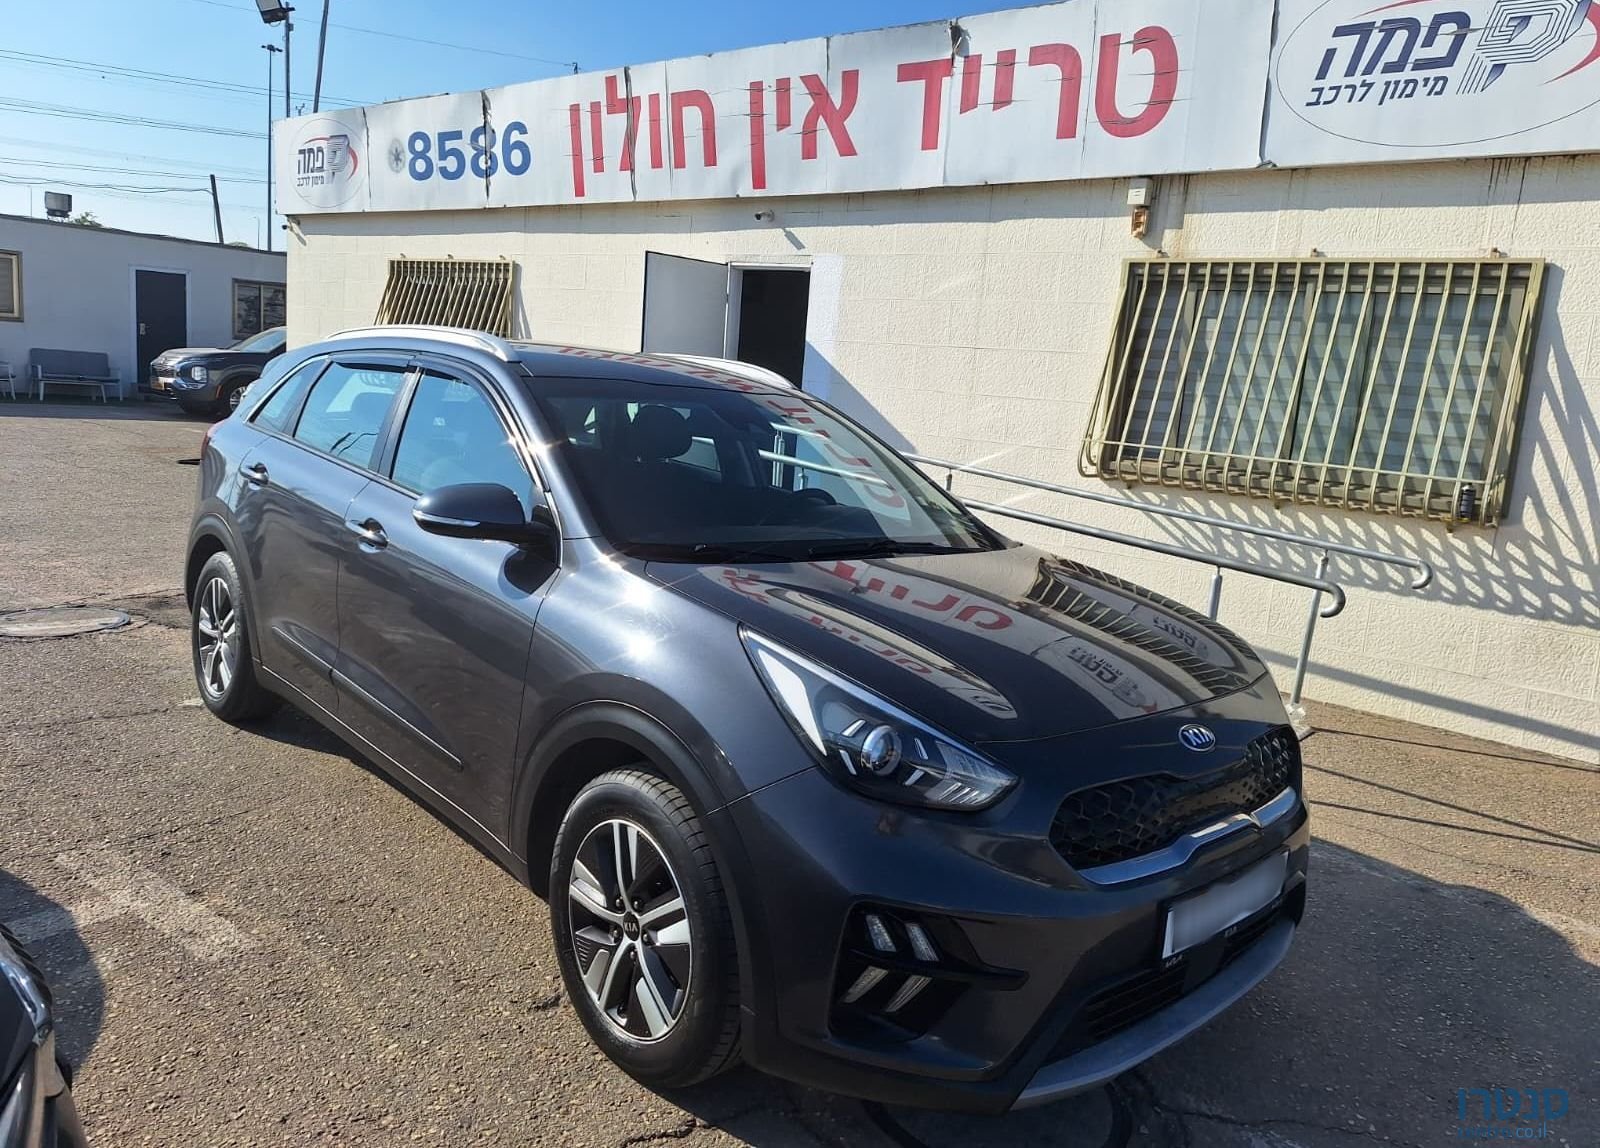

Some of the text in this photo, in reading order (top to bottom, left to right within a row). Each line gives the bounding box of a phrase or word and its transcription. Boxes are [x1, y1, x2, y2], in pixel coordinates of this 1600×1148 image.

[1315, 11, 1472, 80] פמה
[1305, 75, 1449, 107] מימון לרכב
[568, 25, 1178, 197] טרייד אין חולון
[297, 146, 325, 175] פמה
[1183, 727, 1213, 746] KIA
[623, 921, 639, 932] KIA
